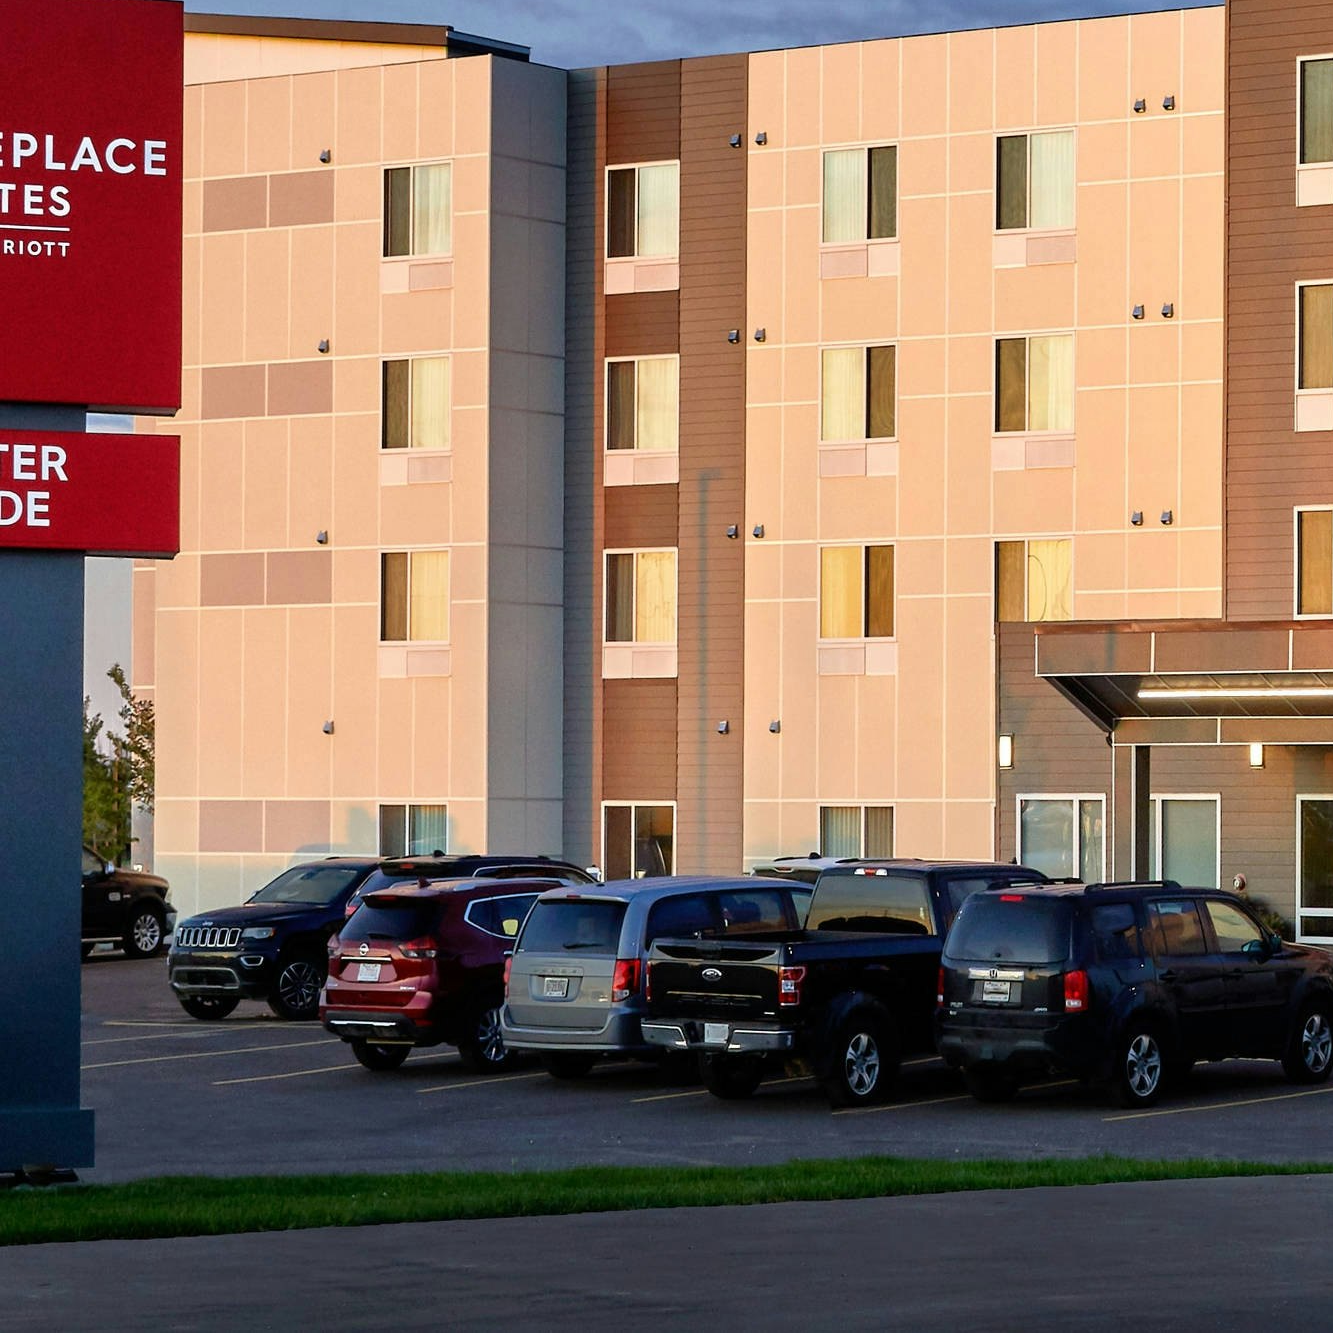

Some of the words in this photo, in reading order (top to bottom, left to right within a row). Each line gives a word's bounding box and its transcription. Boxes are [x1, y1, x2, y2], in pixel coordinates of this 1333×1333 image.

[0, 132, 167, 176] PLACE
[0, 183, 71, 217] TES
[3, 240, 70, 257] RIOTT
[0, 490, 50, 526] DE
